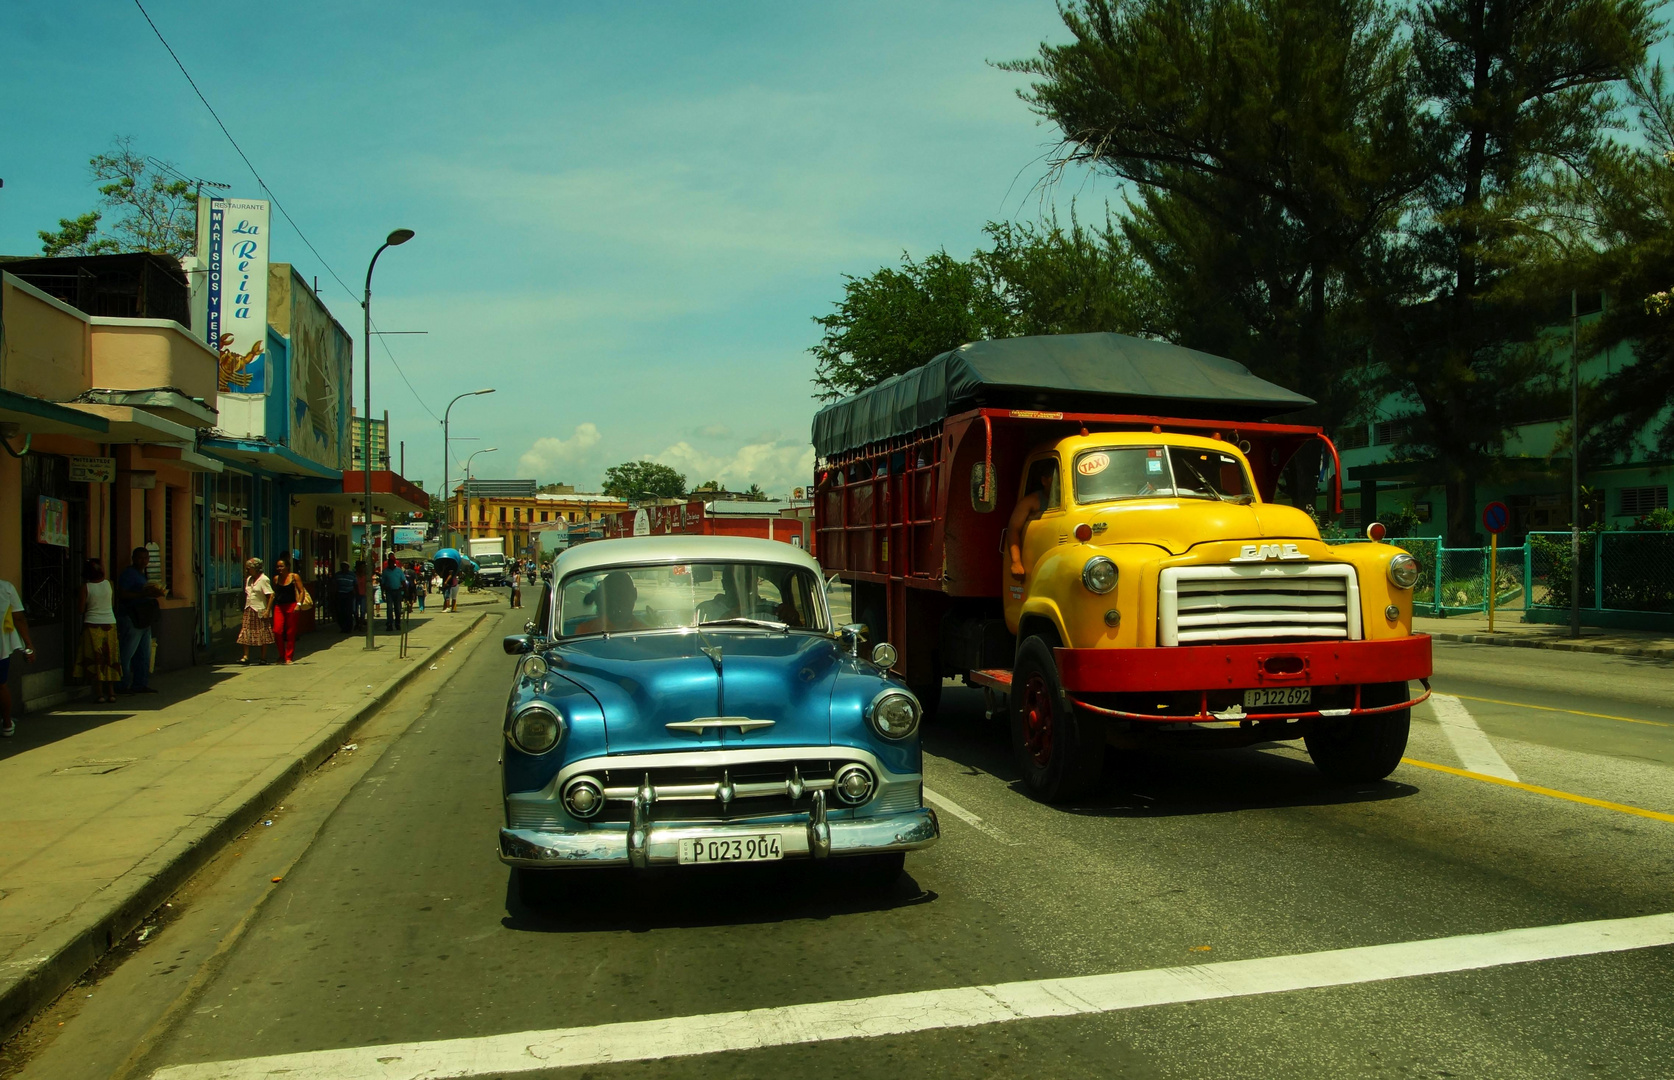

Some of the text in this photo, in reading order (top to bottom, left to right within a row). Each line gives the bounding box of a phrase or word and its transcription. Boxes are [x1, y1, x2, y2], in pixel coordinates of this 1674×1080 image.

[214, 202, 264, 210] RESTAURANTE
[232, 219, 259, 235] La
[211, 213, 222, 291] MARISCOS
[232, 240, 257, 319] Reina
[211, 297, 218, 305] Y
[1081, 456, 1106, 473] TAXI
